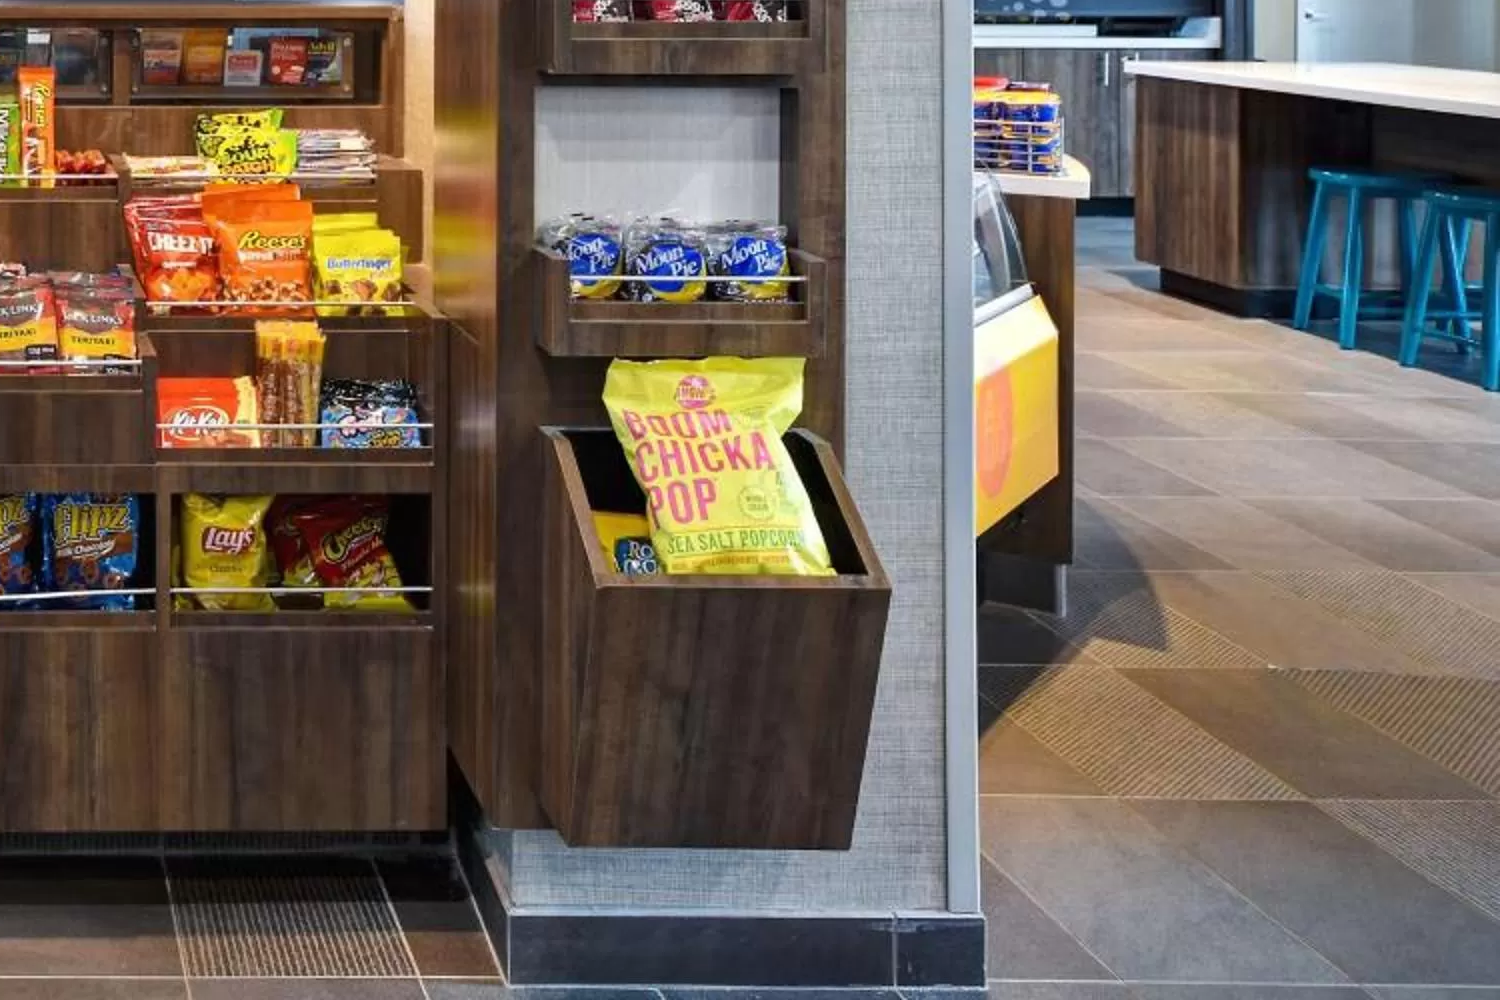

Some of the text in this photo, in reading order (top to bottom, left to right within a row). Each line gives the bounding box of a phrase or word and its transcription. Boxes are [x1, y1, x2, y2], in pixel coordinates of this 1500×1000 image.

[634, 245, 685, 274] Moon
[670, 259, 699, 278] Pie
[721, 239, 768, 269] Moon
[622, 408, 733, 441] BOOM
[635, 431, 776, 483] CHICKA
[648, 477, 717, 529] POP
[204, 526, 255, 554] Lay's
[667, 534, 695, 555] SEA
[699, 531, 736, 551] SALT
